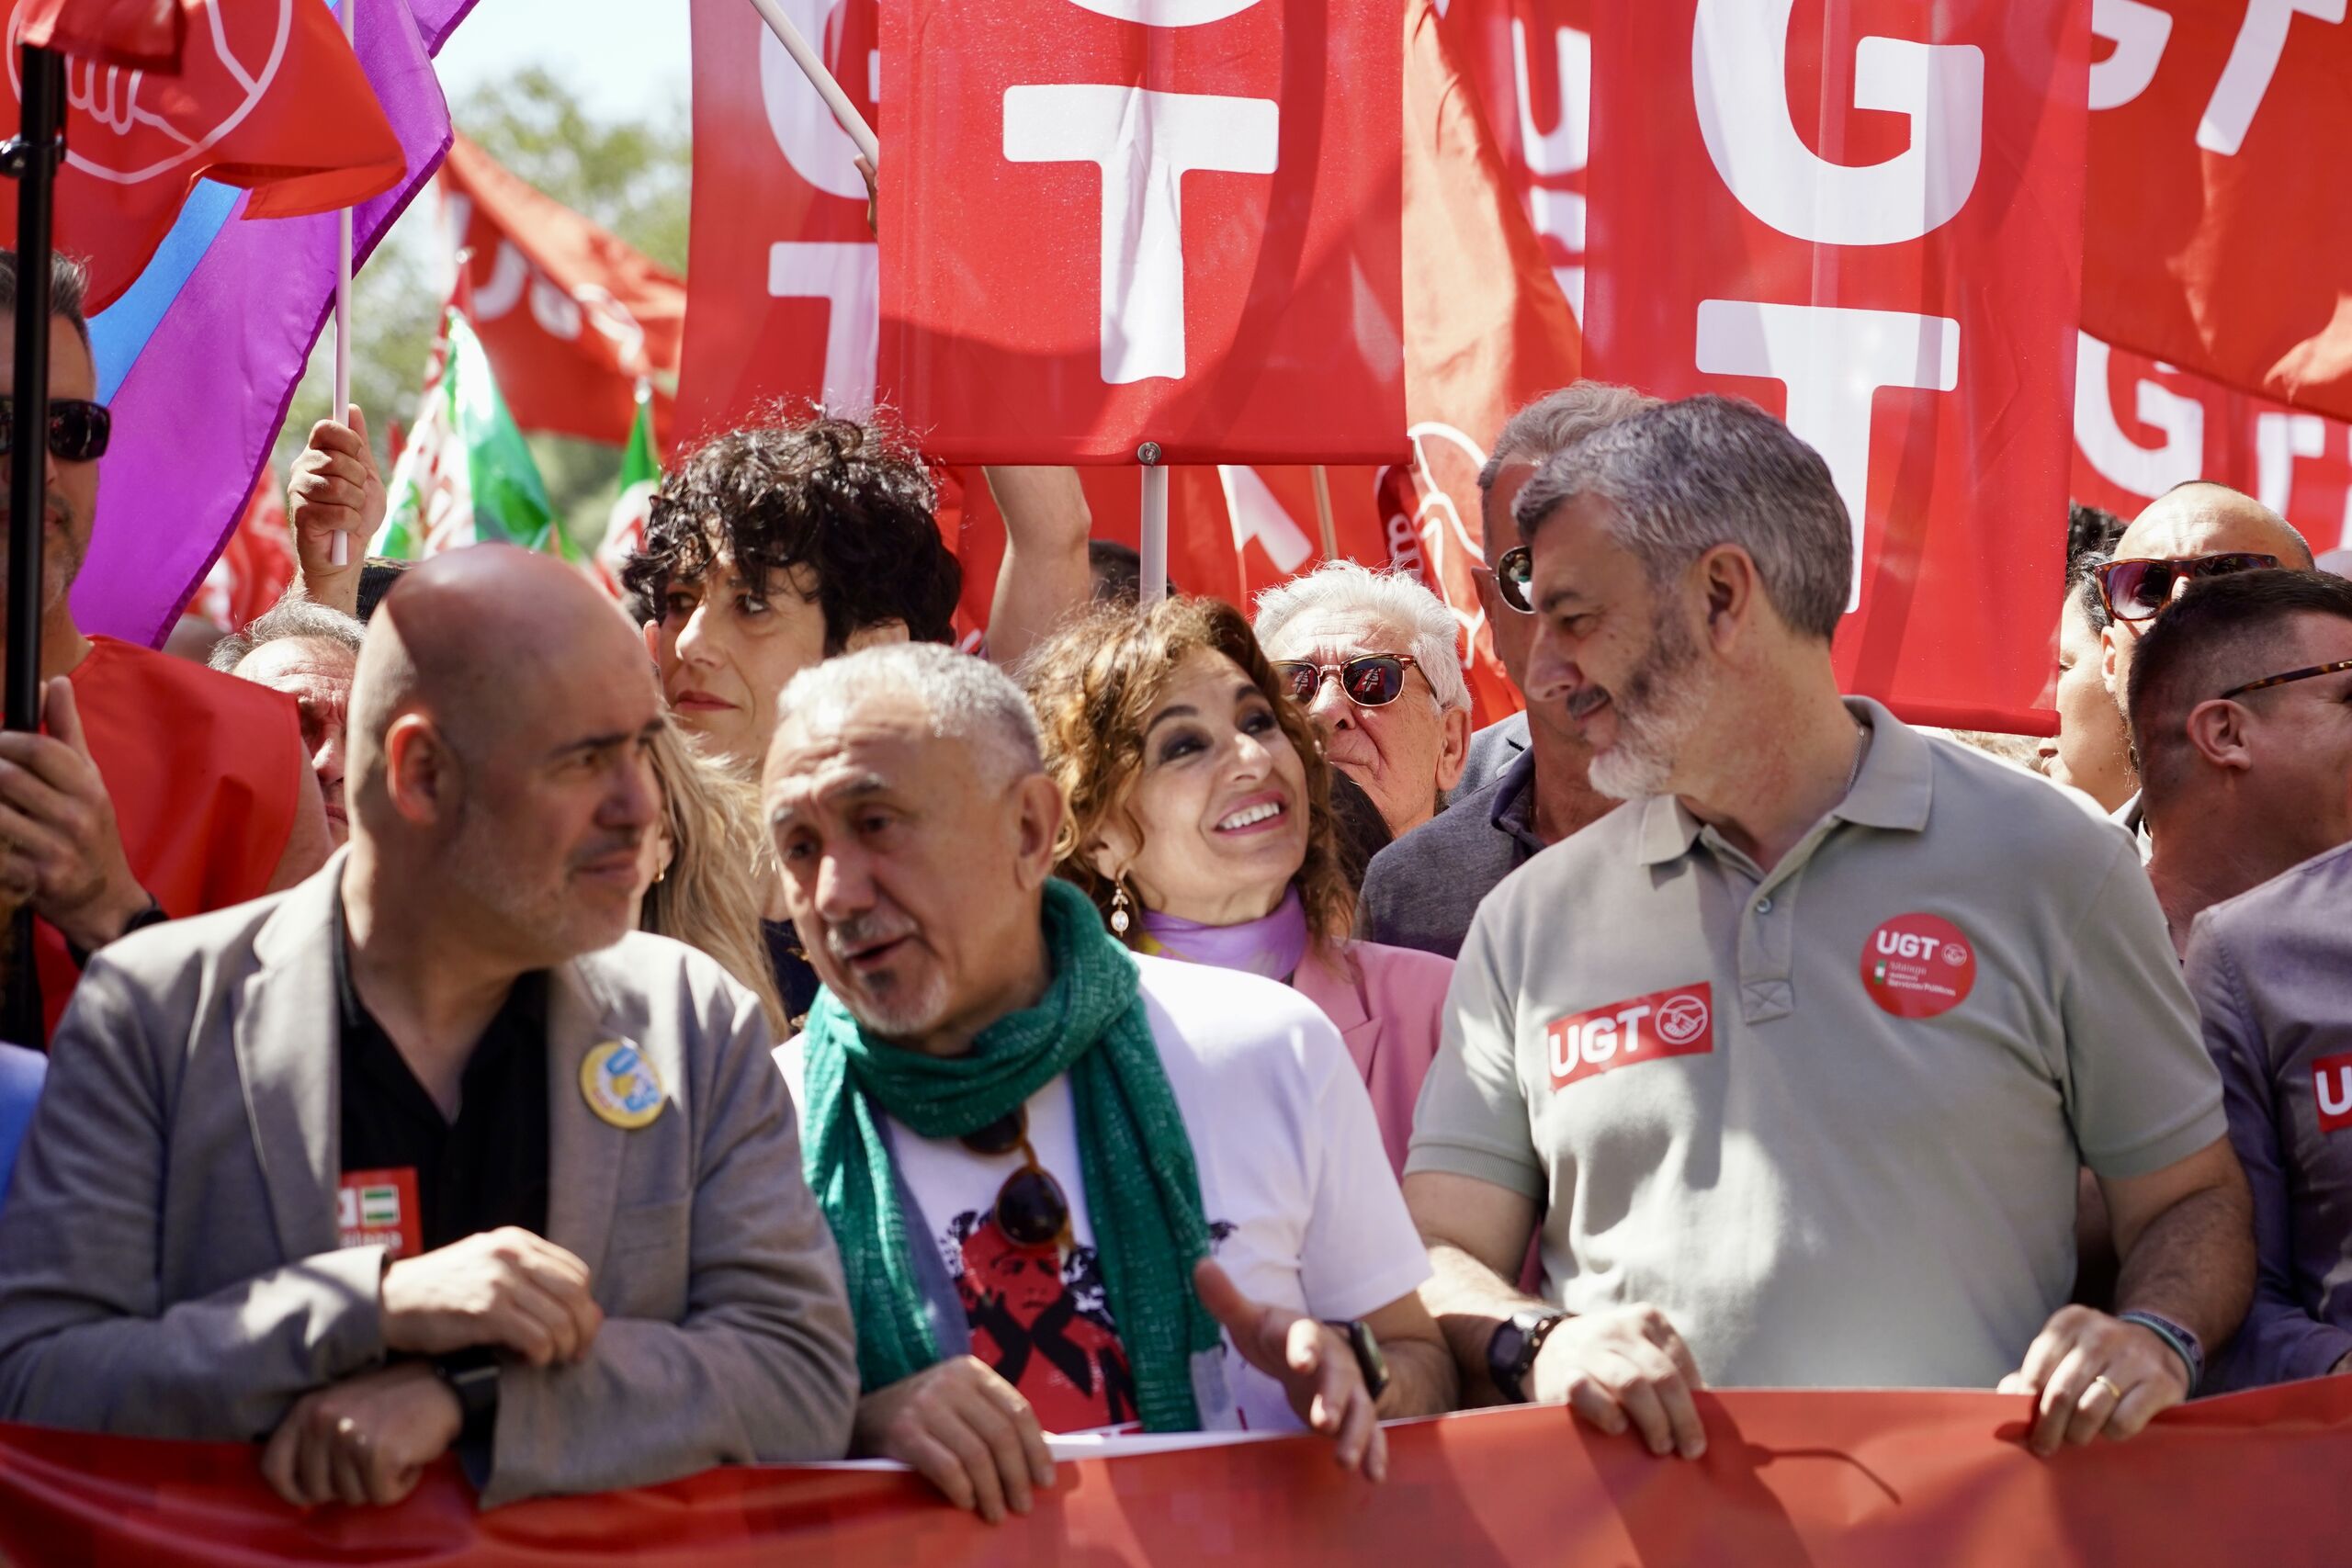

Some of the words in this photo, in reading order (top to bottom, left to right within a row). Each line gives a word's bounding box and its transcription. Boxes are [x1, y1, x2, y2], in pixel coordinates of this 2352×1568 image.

[1002, 0, 1280, 384] T
[1876, 930, 1940, 961] UGT
[1549, 1005, 1651, 1077] UGT
